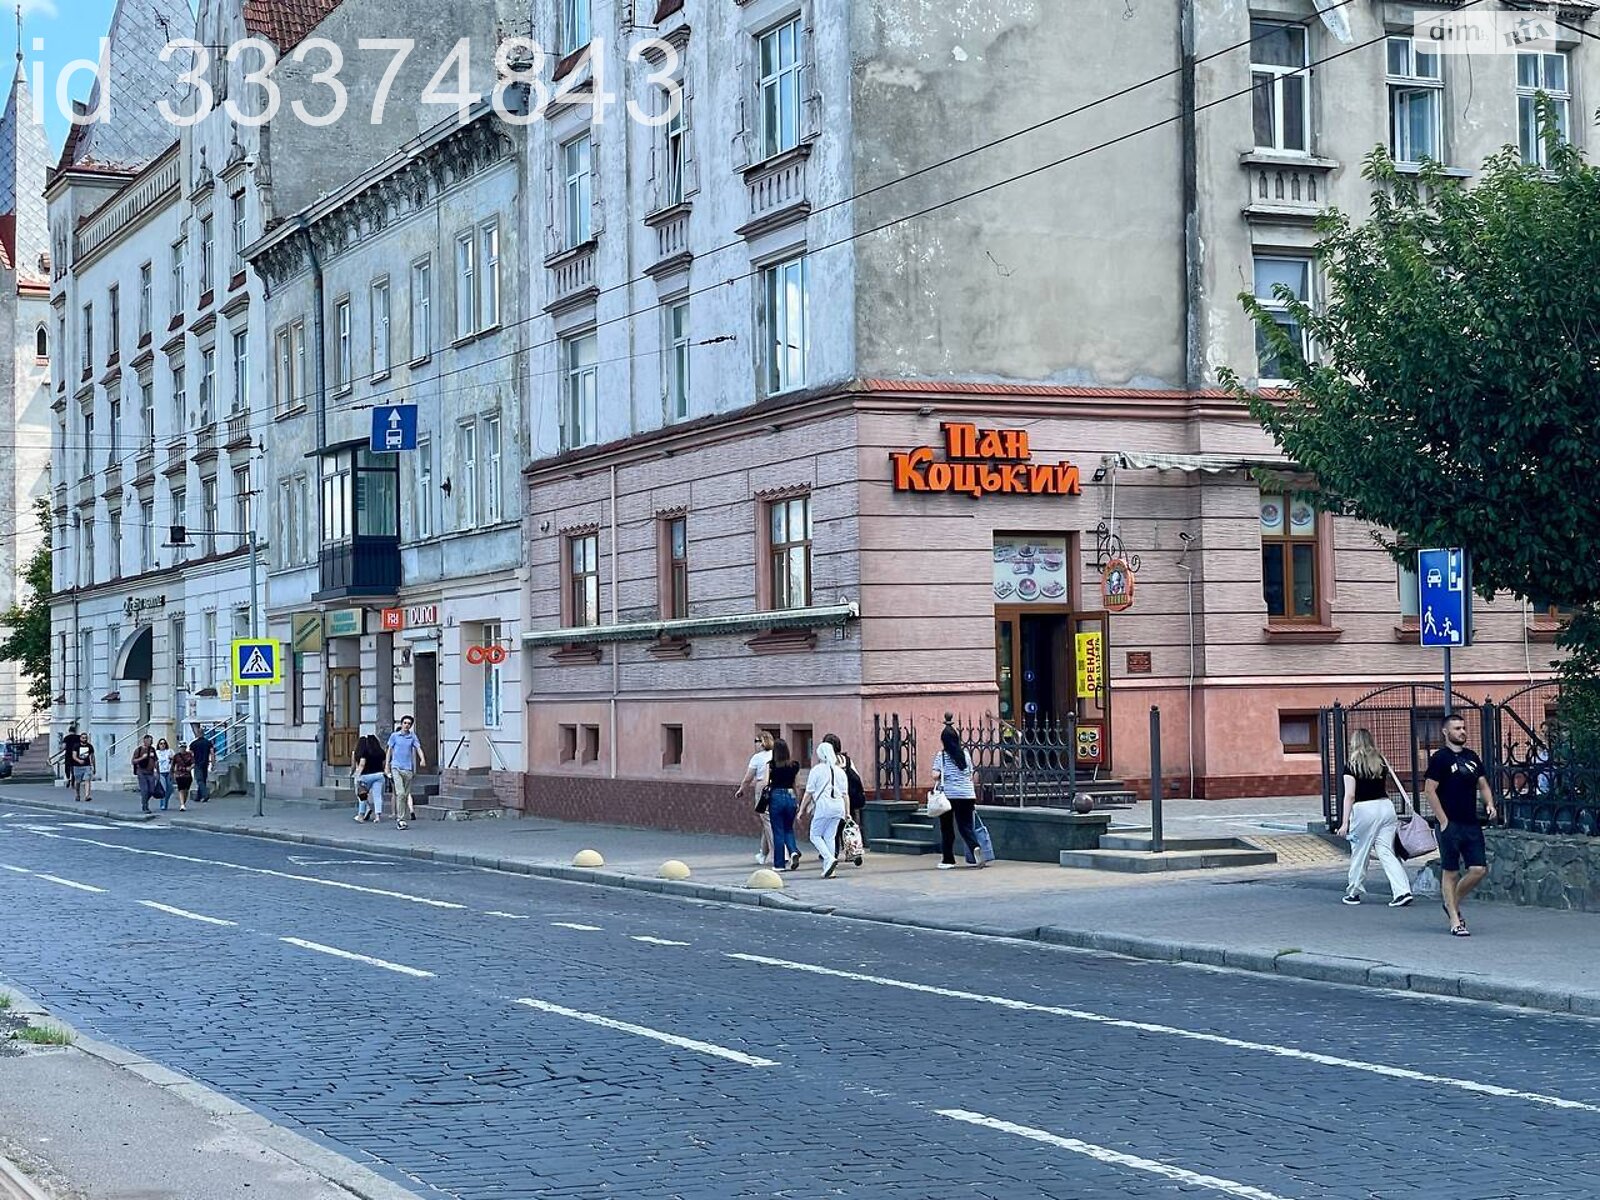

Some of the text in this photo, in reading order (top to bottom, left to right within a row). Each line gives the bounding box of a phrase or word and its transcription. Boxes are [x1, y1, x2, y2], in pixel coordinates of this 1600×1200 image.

[939, 422, 1032, 461] Пан
[889, 445, 1082, 498] Коцький
[1086, 638, 1095, 691] ОРЕНДА
